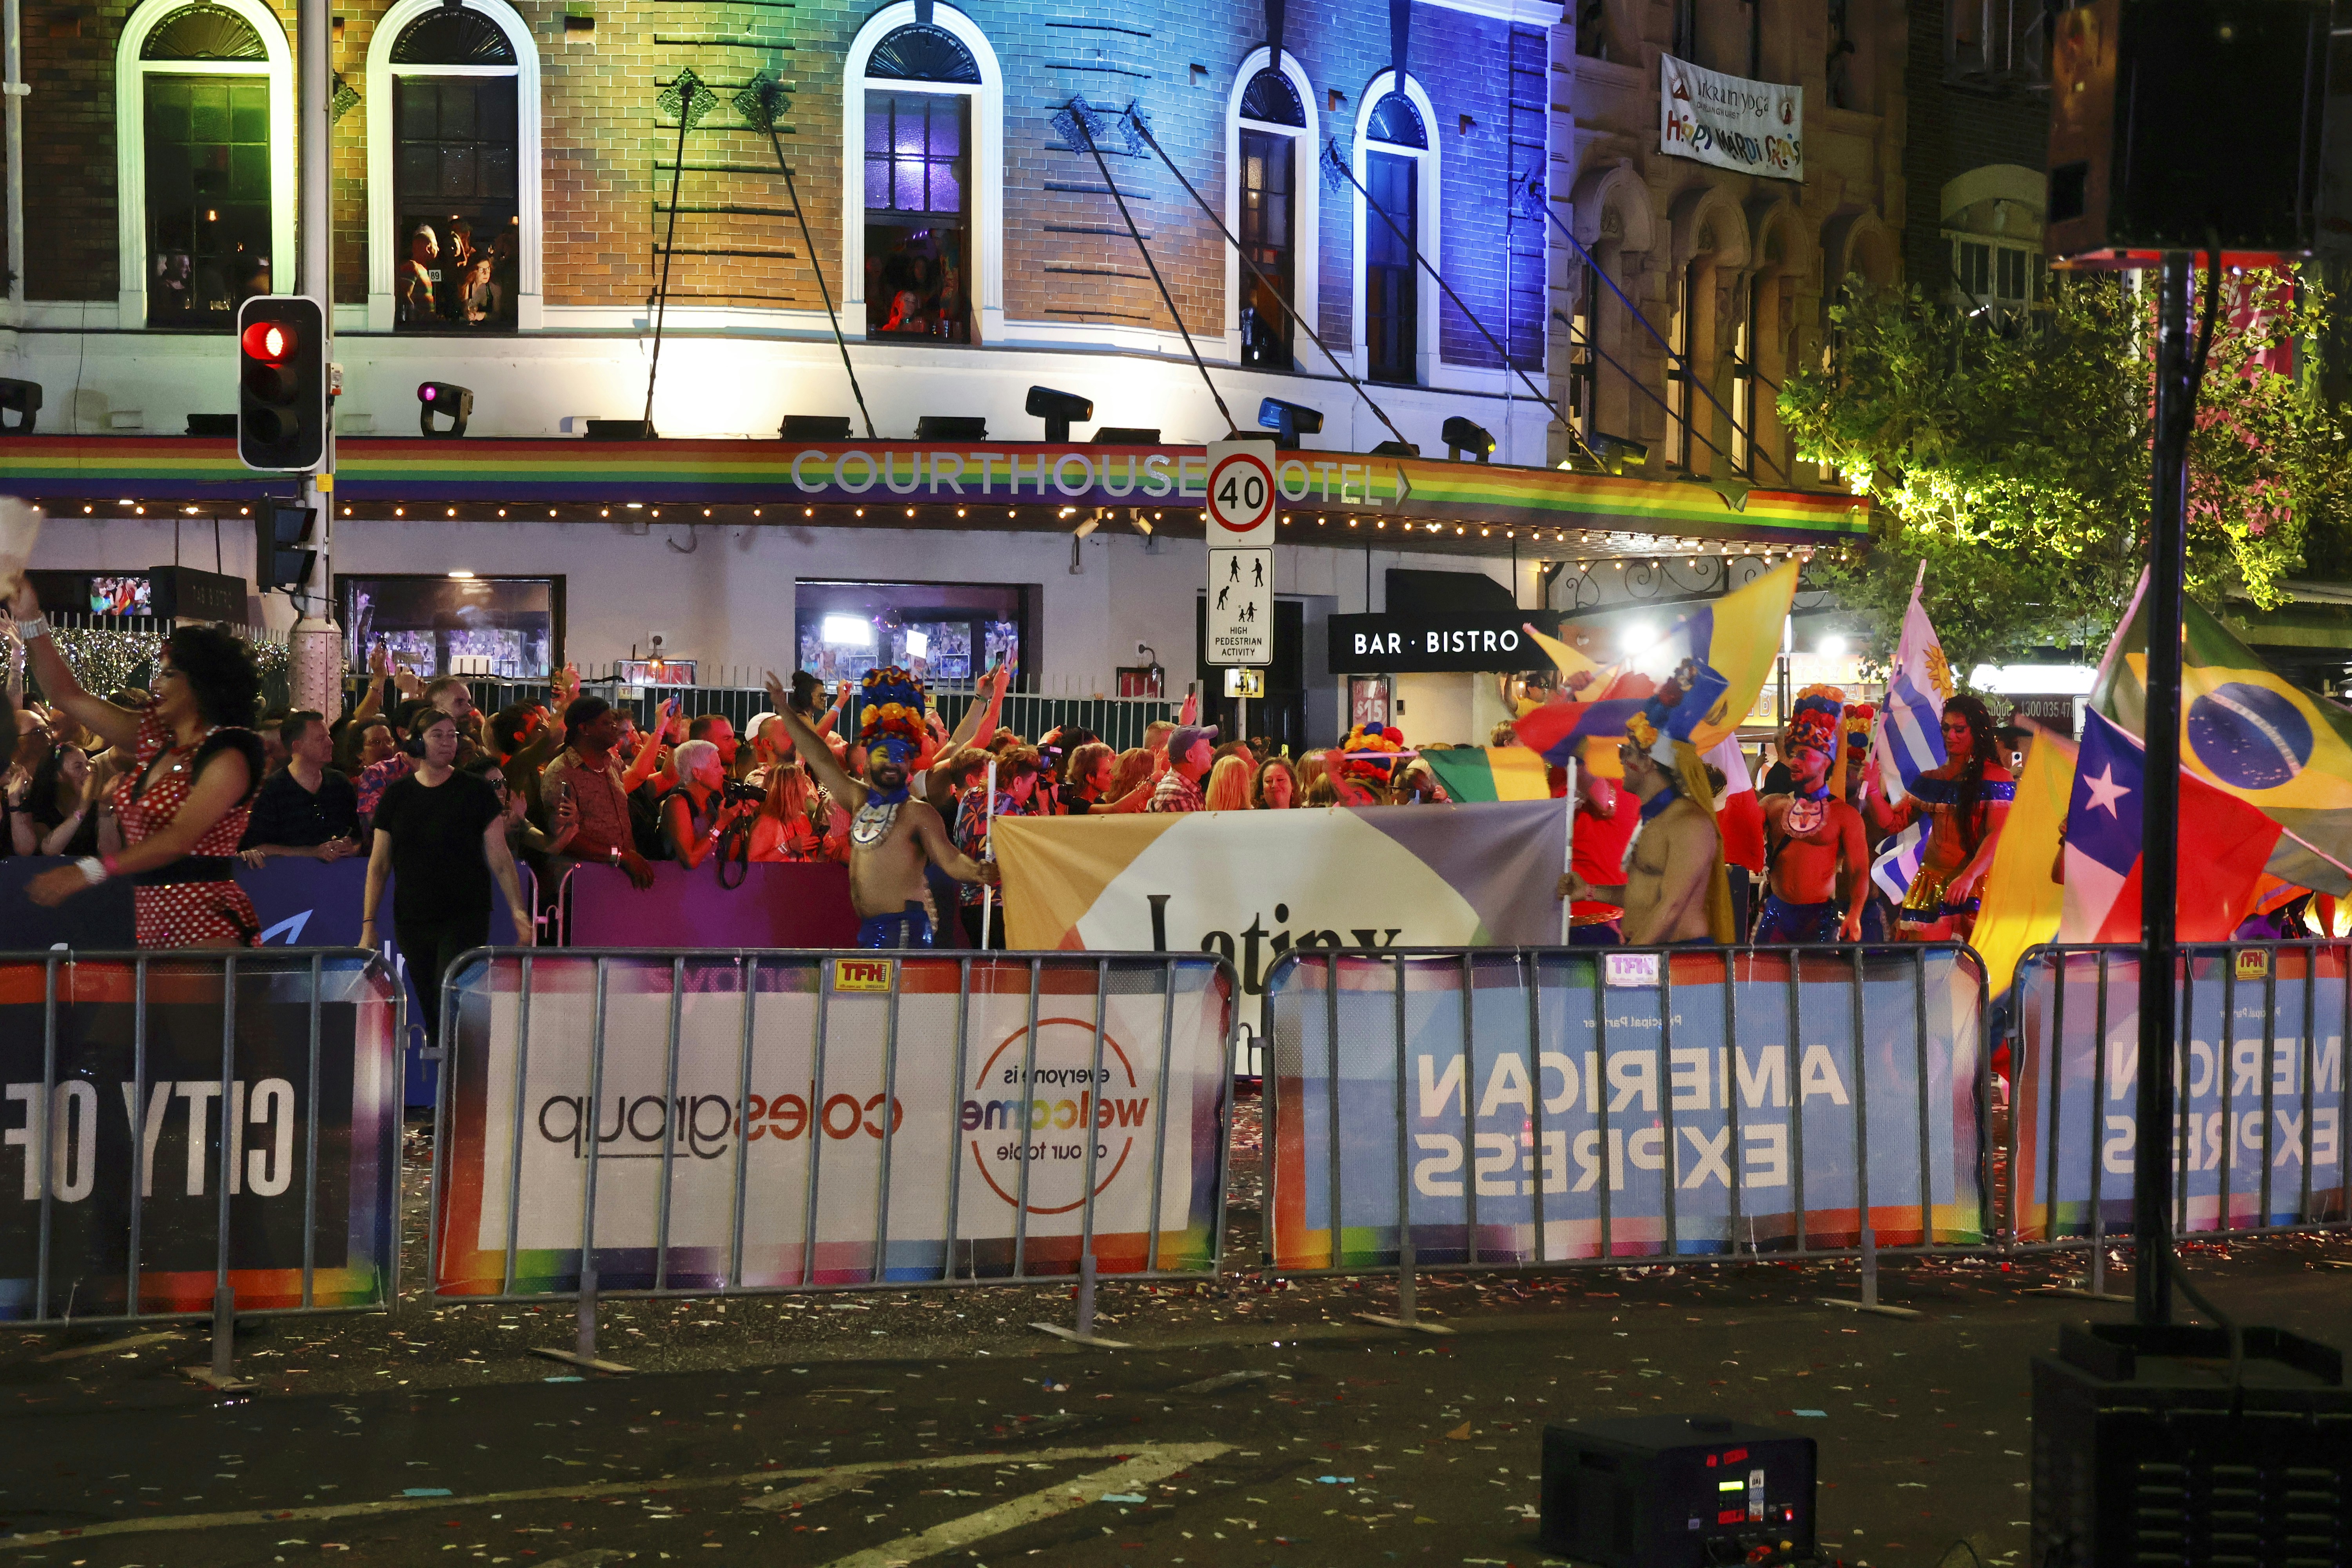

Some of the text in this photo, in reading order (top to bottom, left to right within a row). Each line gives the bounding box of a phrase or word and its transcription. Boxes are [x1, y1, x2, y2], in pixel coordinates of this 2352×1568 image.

[1741, 92, 1769, 117] yoga
[791, 449, 1382, 505] COURTHOUSE OTEL
[1218, 476, 1264, 509] 40
[1230, 626, 1247, 635] HIGH
[1215, 637, 1262, 646] PEDESTRIAN
[1354, 630, 1519, 655] BAR BISTRO
[1222, 648, 1255, 656] ACTIVITY
[1357, 699, 1383, 722] $15
[2021, 701, 2041, 717] 1300
[2043, 701, 2058, 717] 035
[2061, 701, 2073, 718] 47
[842, 963, 882, 981] TFH
